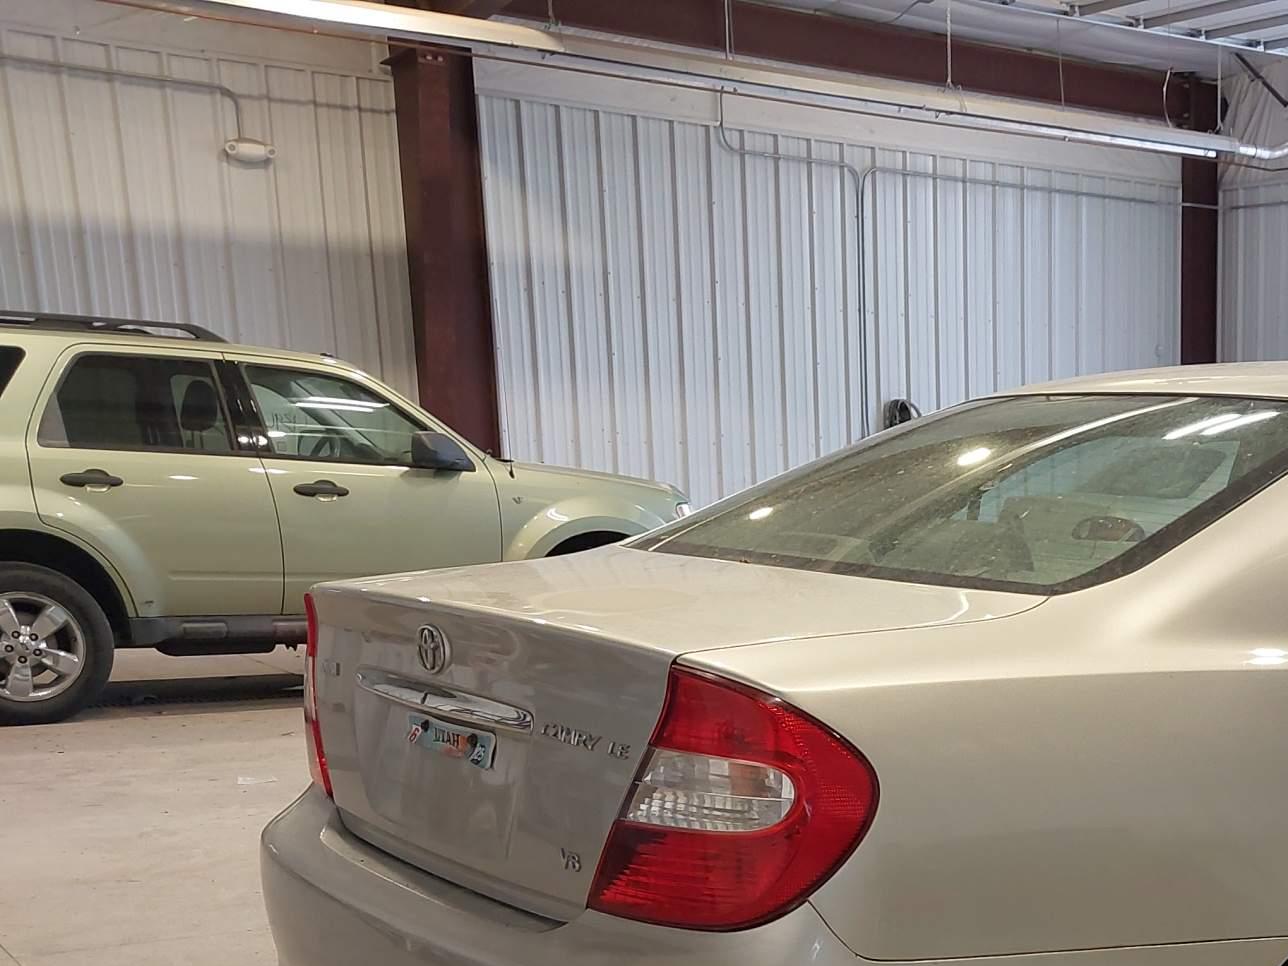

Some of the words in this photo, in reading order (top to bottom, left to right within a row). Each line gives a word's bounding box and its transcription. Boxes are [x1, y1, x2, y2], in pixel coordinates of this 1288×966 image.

[433, 728, 460, 748] UTAH
[541, 724, 602, 750] CAMRY
[607, 741, 631, 760] LE
